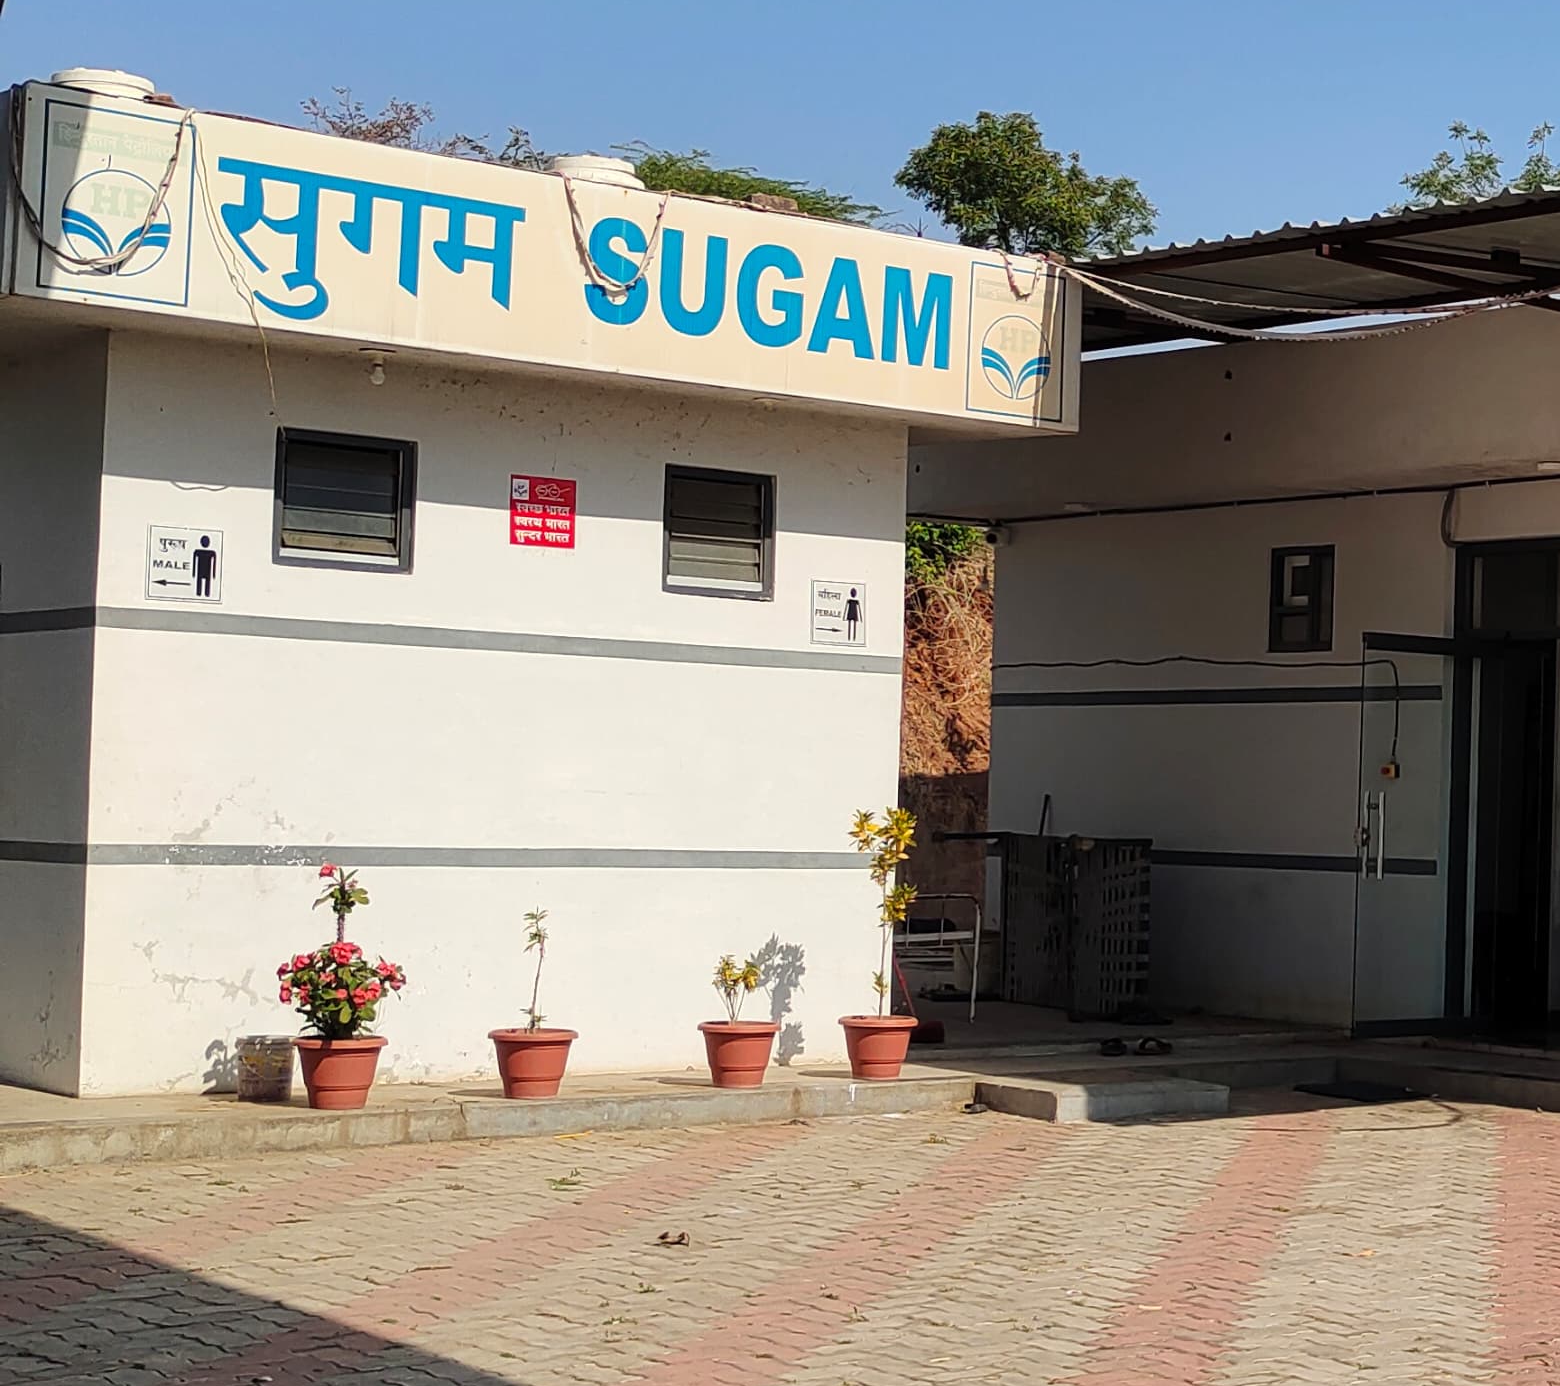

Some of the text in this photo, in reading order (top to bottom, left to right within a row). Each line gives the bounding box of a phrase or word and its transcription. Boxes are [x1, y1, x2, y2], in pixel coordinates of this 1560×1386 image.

[218, 156, 953, 370] सुगम SUGAM
[153, 559, 191, 570] MALE
